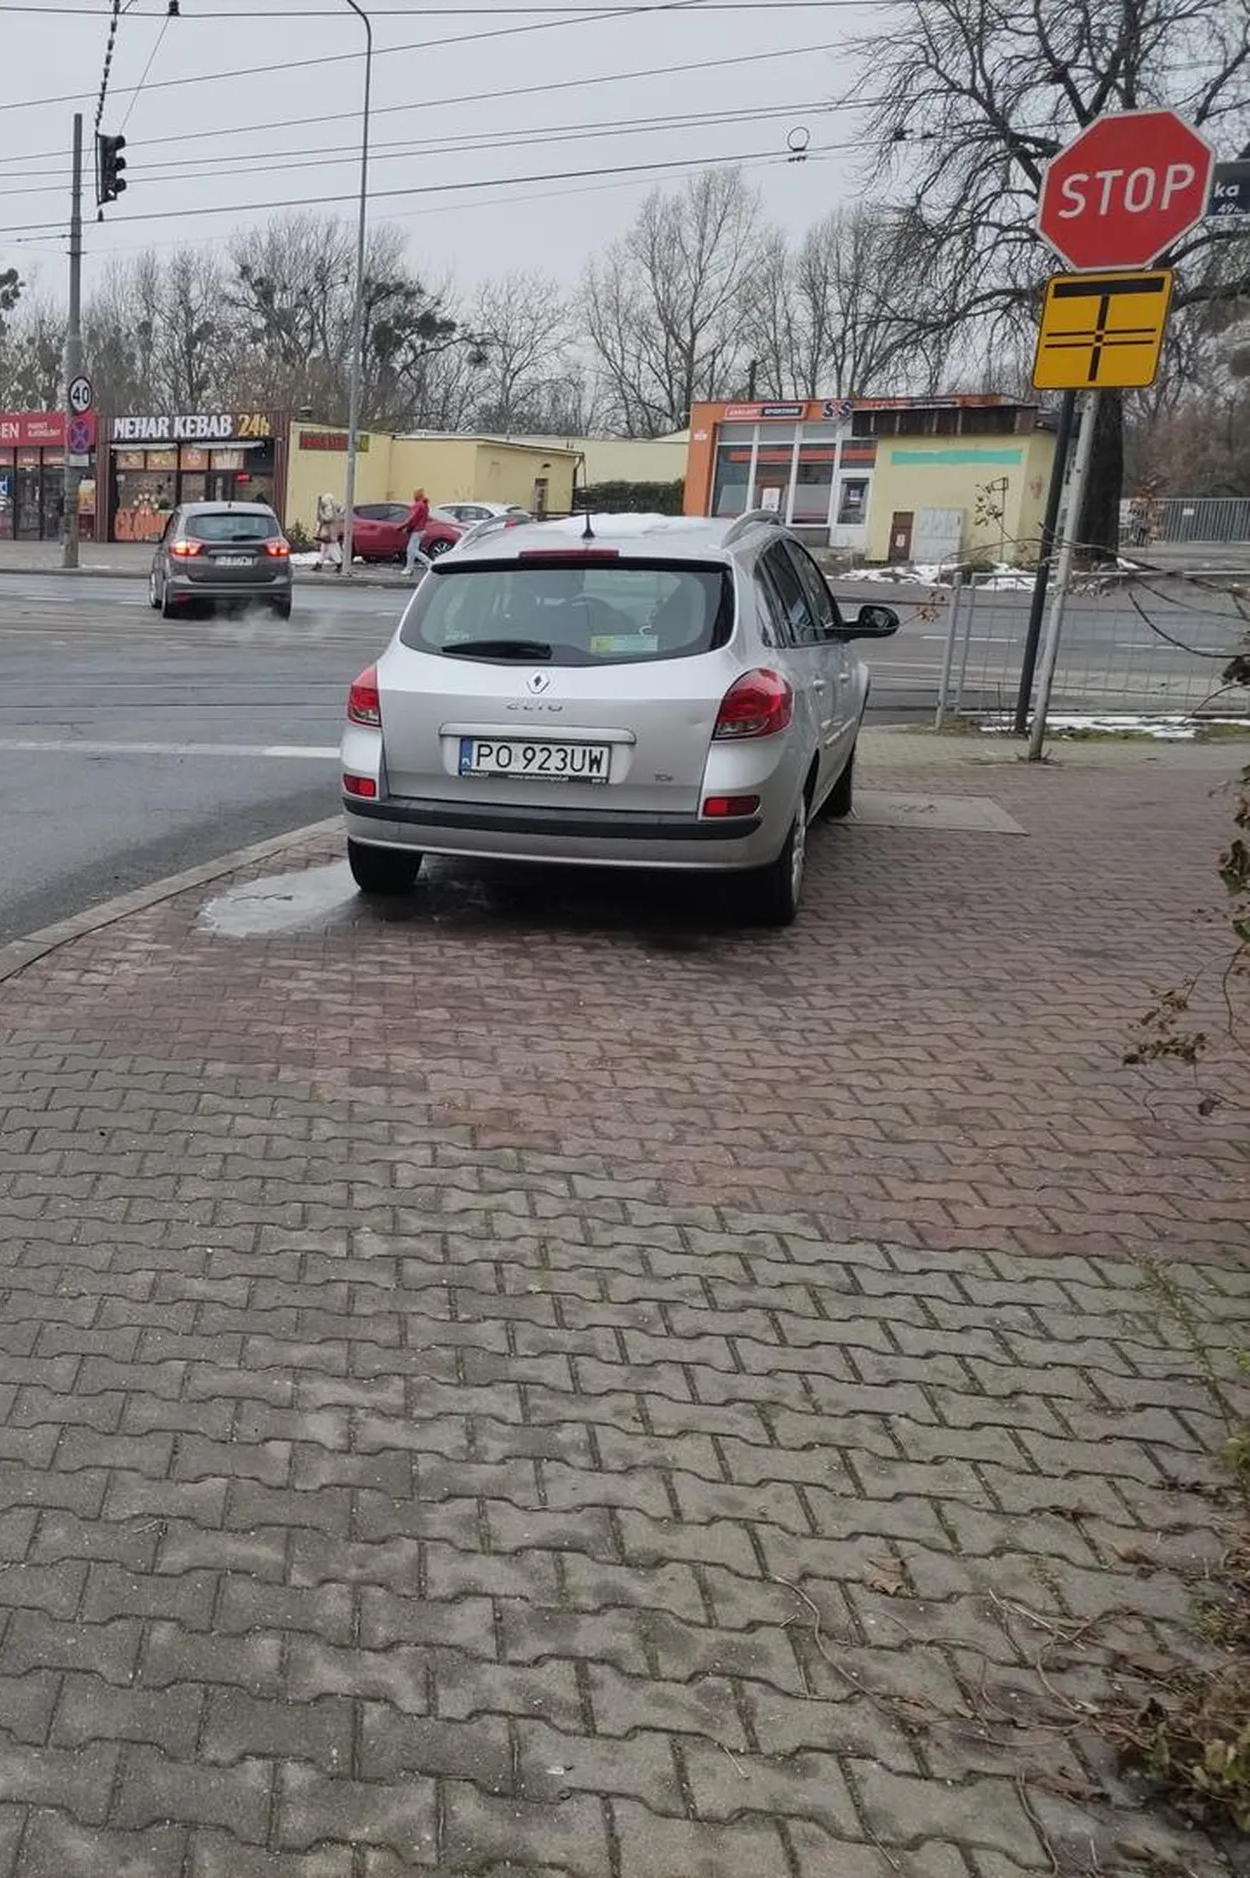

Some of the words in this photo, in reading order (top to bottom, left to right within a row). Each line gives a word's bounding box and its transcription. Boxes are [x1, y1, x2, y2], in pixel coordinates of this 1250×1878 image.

[1058, 163, 1195, 219] STOP
[1214, 180, 1240, 198] ka
[72, 386, 89, 404] 40
[113, 415, 169, 440] NEHAR
[173, 415, 232, 438] KEBAB
[238, 415, 270, 437] 24h
[476, 744, 512, 769] PO
[522, 746, 603, 773] 923UW
